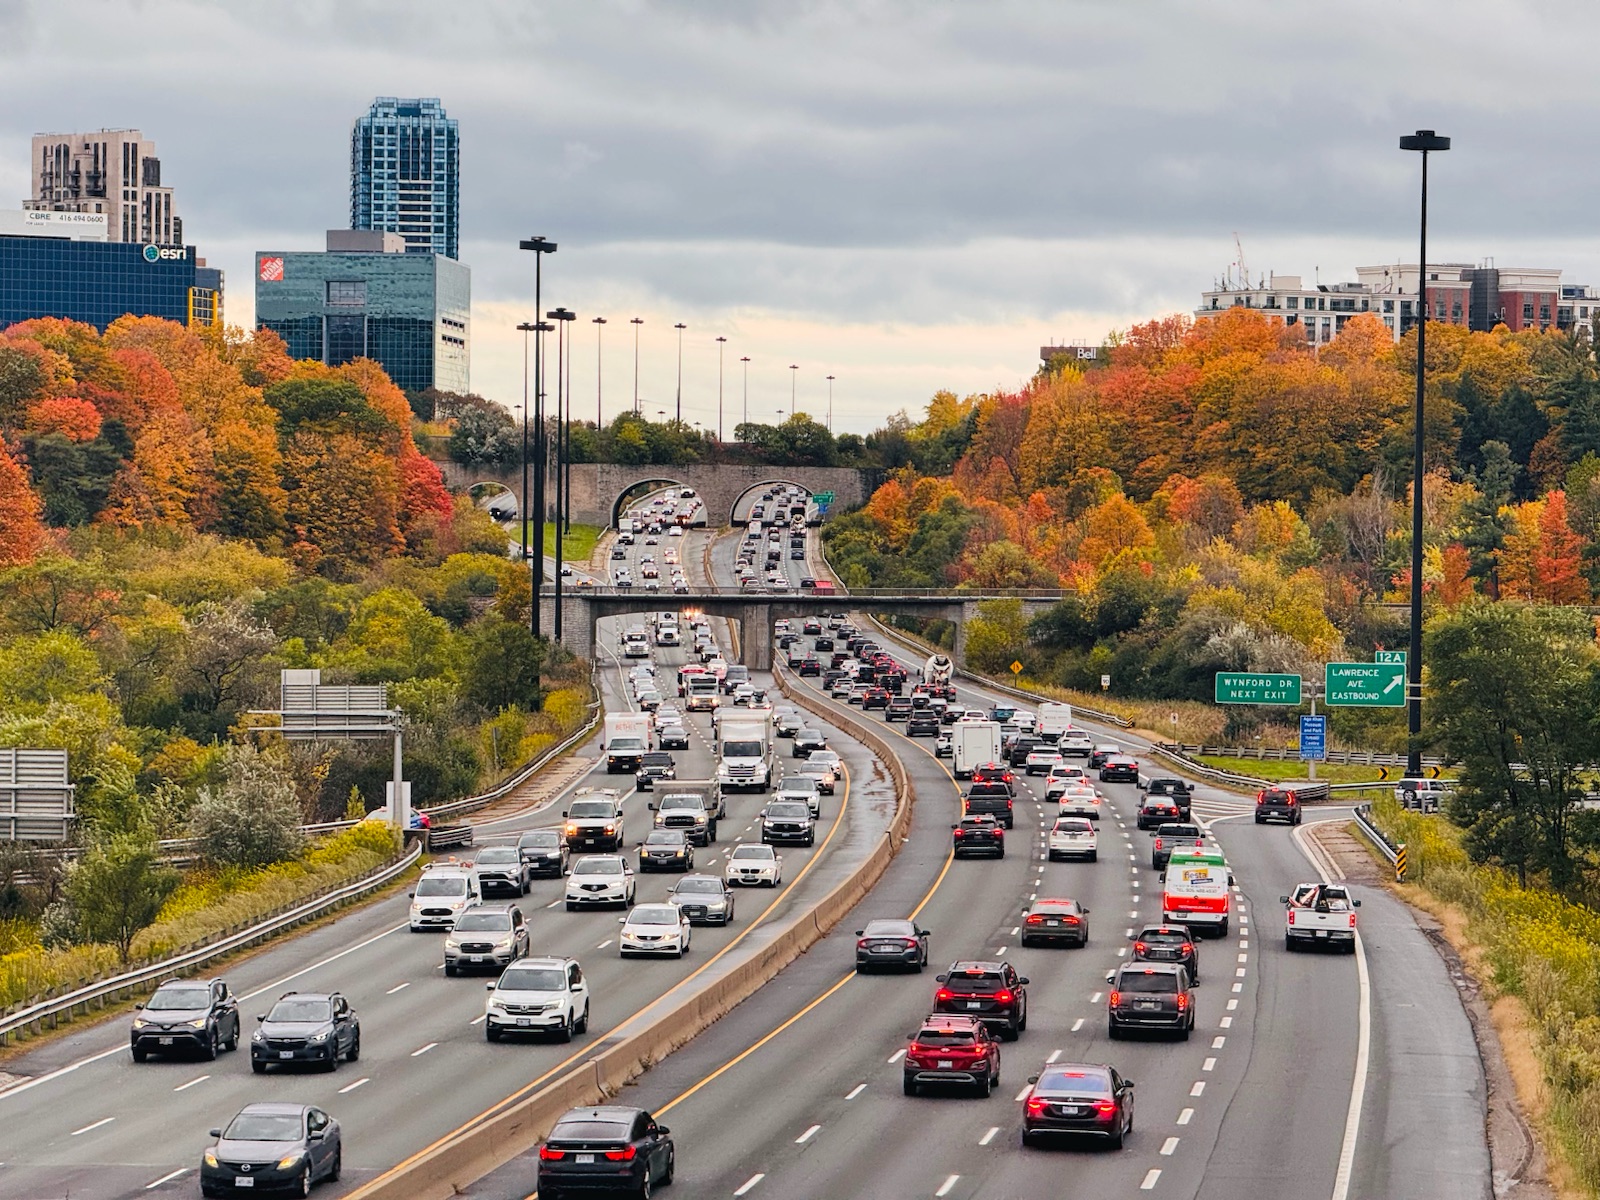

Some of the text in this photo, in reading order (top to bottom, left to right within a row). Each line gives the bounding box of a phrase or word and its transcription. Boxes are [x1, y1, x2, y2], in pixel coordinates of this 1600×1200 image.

[29, 212, 51, 220] CBRE
[59, 214, 72, 222] 416
[87, 215, 104, 223] 0600
[160, 245, 187, 260] esri
[260, 258, 283, 281] HOME
[1077, 347, 1097, 359] Bell
[1380, 653, 1402, 662] 12A
[1332, 668, 1380, 677] LAWRENCE
[1223, 678, 1295, 688] WYNFORD DR.
[1347, 680, 1366, 688] AVE.
[1230, 690, 1287, 699] NEXT EXIT
[1331, 692, 1380, 700] EASTBOUND
[1184, 870, 1208, 879] fiesta
